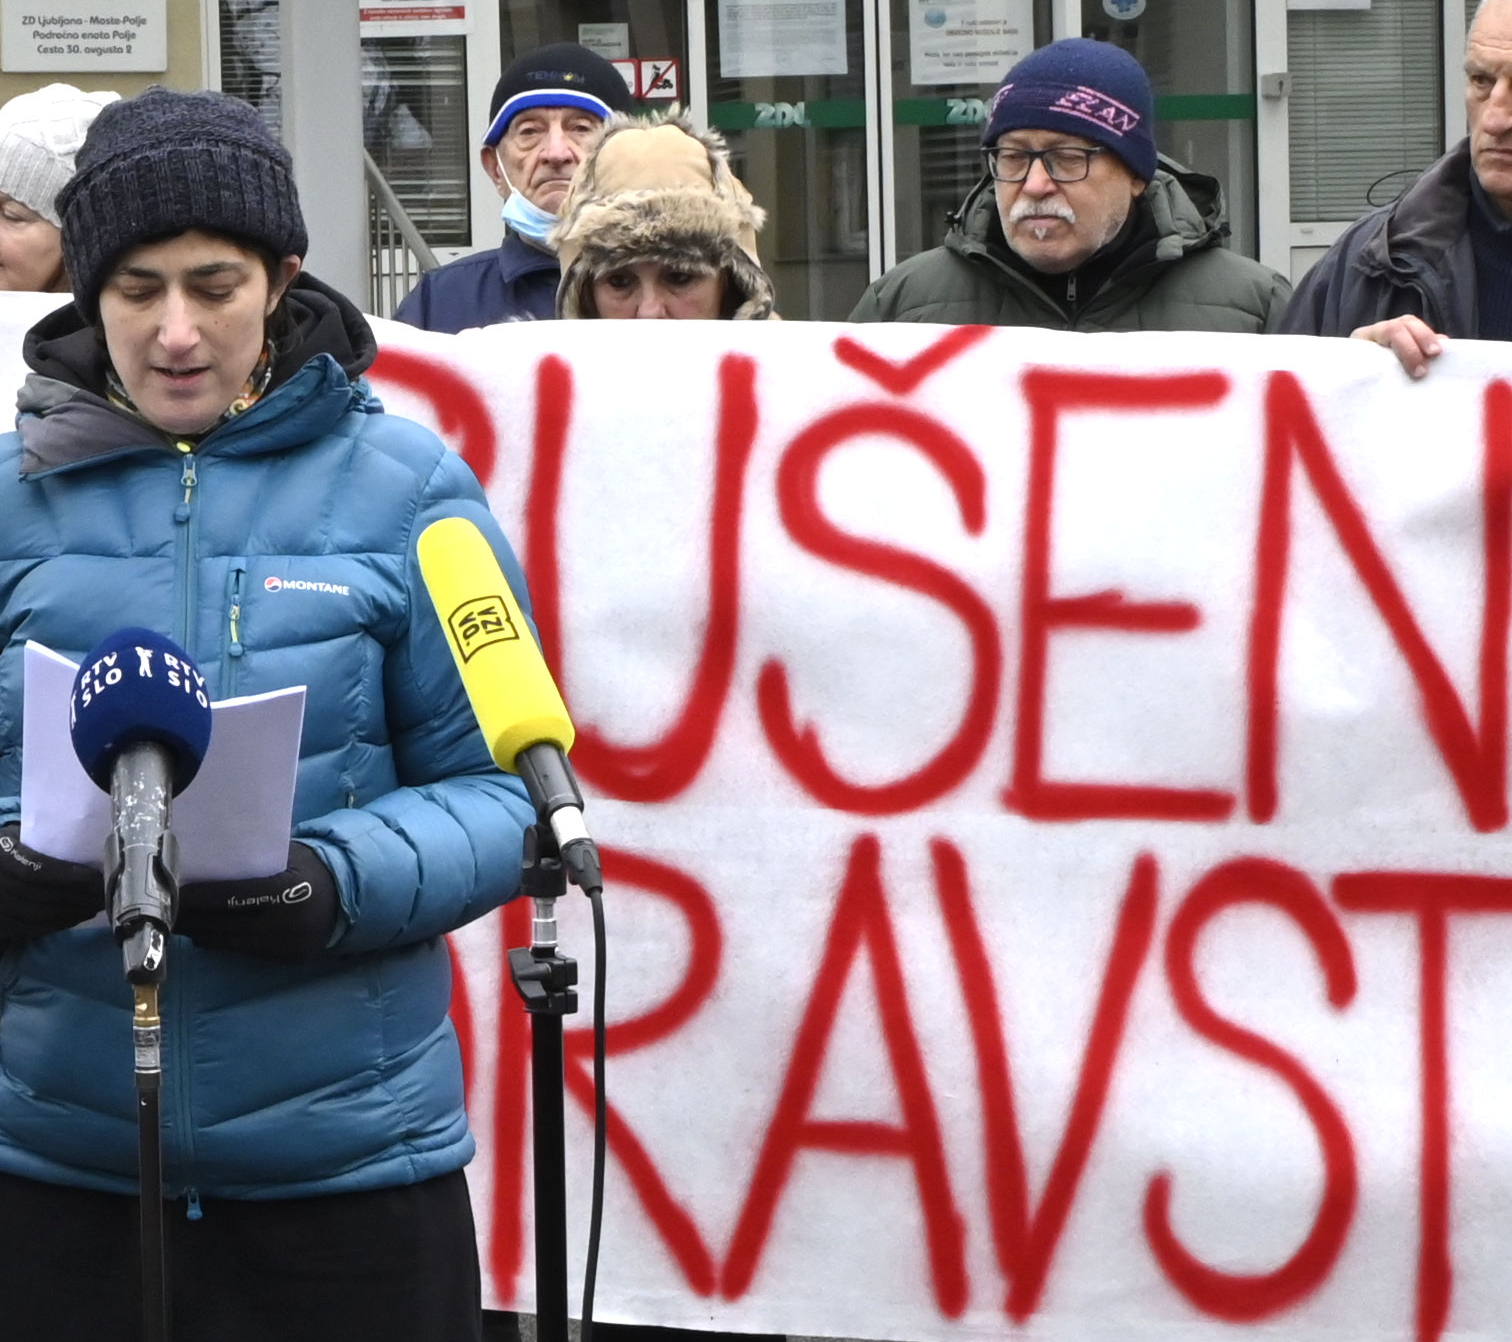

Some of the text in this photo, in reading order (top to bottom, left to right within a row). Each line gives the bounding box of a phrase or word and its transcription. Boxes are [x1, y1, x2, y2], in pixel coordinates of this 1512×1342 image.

[22, 16, 36, 25] ZD
[38, 15, 83, 27] Ljubljana
[90, 15, 147, 27] Moste-Polje
[112, 30, 136, 42] Polje
[37, 45, 64, 54] Cesta
[66, 44, 82, 54] 30.
[84, 45, 124, 56] avgusta
[282, 579, 350, 596] MONTANE
[81, 651, 118, 690] RTV
[163, 652, 206, 688] RTV
[82, 667, 123, 708] SLO
